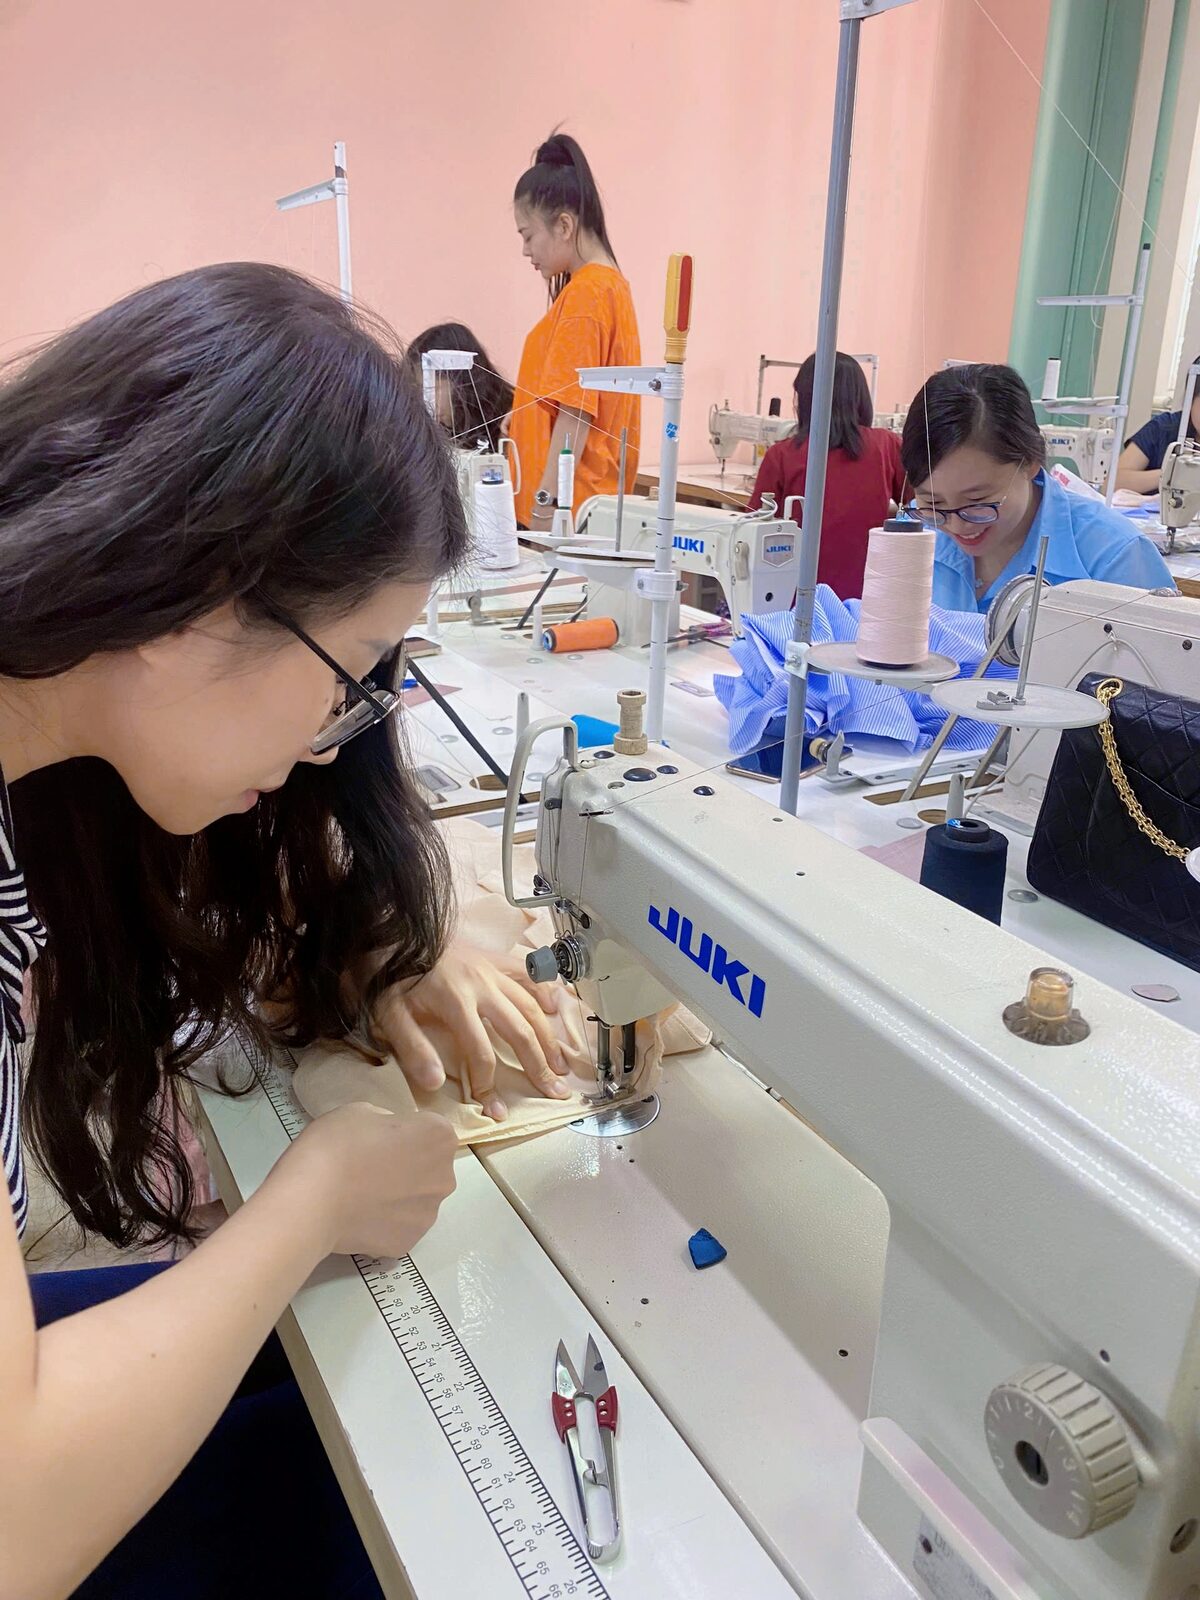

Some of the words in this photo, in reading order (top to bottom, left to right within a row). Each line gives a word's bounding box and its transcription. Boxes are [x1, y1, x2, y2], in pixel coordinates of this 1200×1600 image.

[766, 545, 791, 553] JUKI
[648, 905, 766, 1019] JUKI
[393, 1298, 403, 1307] 50
[410, 1305, 421, 1315] 20
[401, 1312, 411, 1321] 51
[408, 1326, 419, 1336] 52
[416, 1341, 427, 1351] 53
[431, 1342, 442, 1352] 21
[426, 1357, 437, 1367] 54
[433, 1372, 445, 1383] 55
[442, 1387, 453, 1399] 56
[453, 1382, 465, 1392] 22
[451, 1405, 464, 1415] 57
[1023, 1402, 1034, 1419] 2
[461, 1421, 472, 1433] 58
[478, 1424, 490, 1436] 23
[470, 1439, 482, 1451] 59
[480, 1457, 493, 1470] 60
[491, 1477, 503, 1489] 61
[503, 1471, 516, 1484] 24
[502, 1497, 515, 1511] 62
[513, 1519, 527, 1532] 63
[531, 1522, 546, 1536] 25
[525, 1539, 538, 1553] 64
[536, 1560, 550, 1576] 65
[549, 1584, 562, 1599] 66
[564, 1580, 578, 1595] 26
